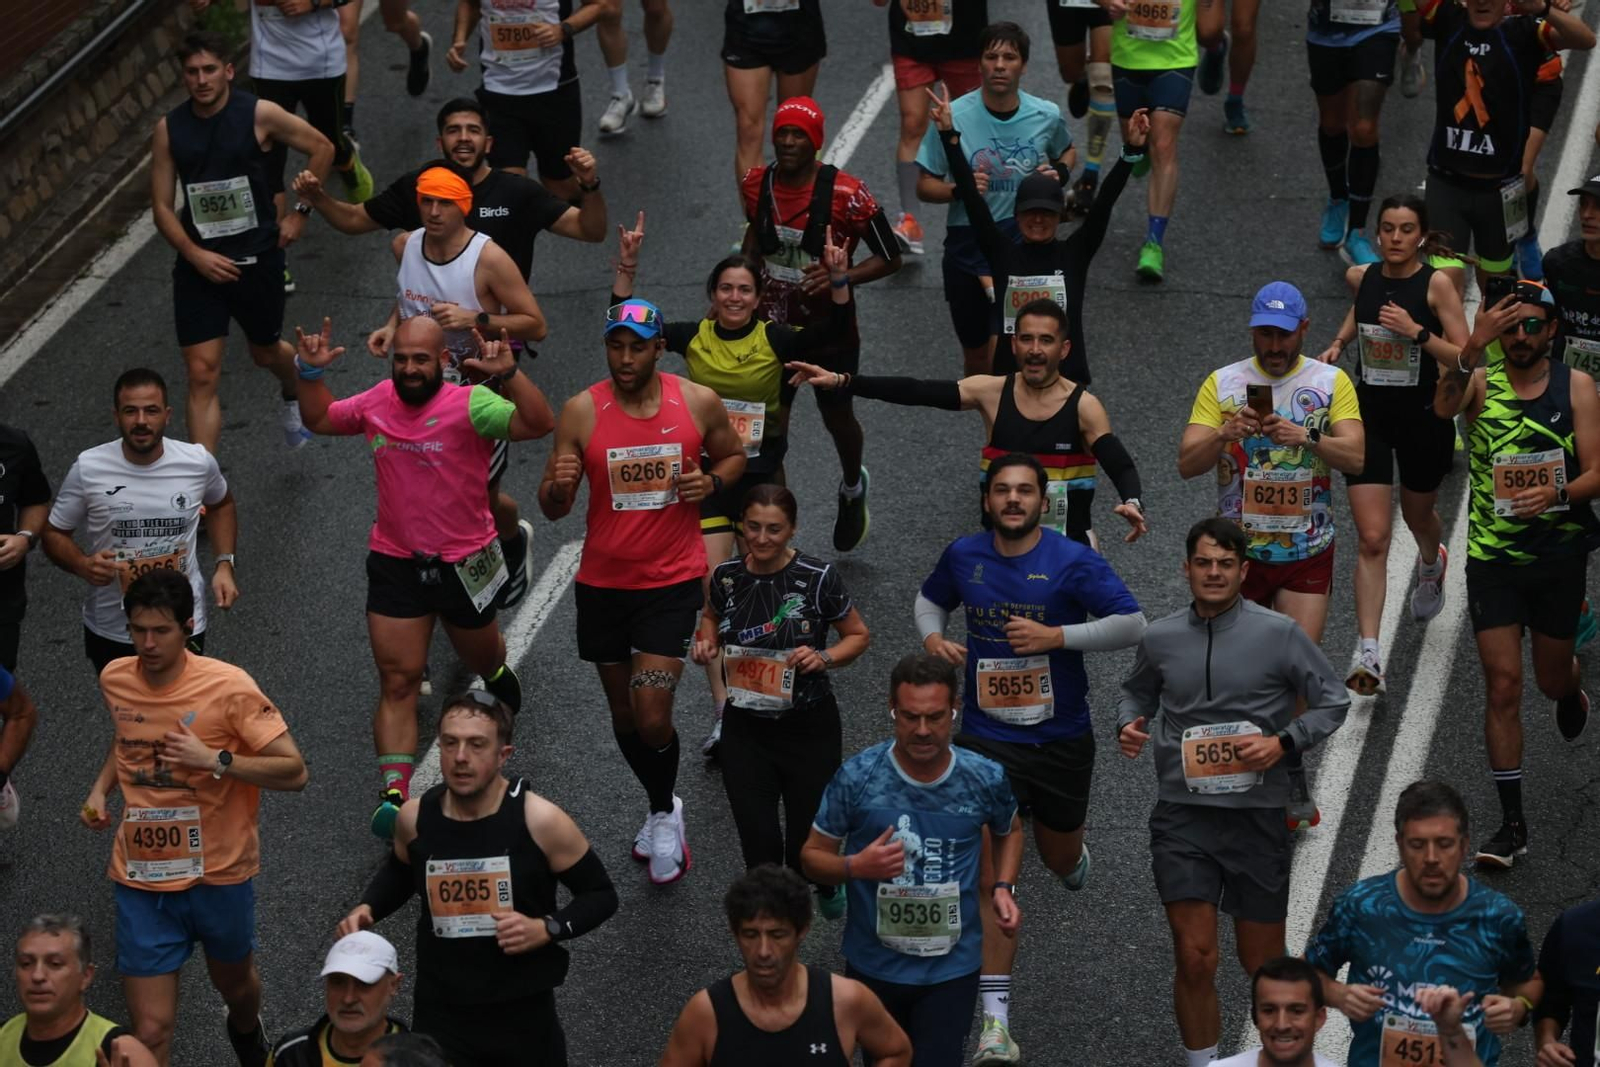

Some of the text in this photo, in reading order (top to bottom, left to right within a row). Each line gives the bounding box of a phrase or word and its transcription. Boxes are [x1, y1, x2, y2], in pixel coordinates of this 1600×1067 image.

[1135, 4, 1169, 19] 4968
[498, 27, 531, 42] 5780
[1446, 126, 1496, 155] ELA
[199, 193, 237, 213] 9521
[479, 206, 510, 218] Birds
[1366, 339, 1404, 361] 7393
[621, 461, 666, 483] 6266
[1504, 467, 1549, 488] 5826
[1254, 485, 1298, 505] 6213
[967, 605, 1045, 621] FUENTES
[737, 661, 776, 684] 4971
[988, 675, 1034, 696] 5655
[133, 826, 181, 848] 4390
[439, 879, 490, 903] 6265
[890, 903, 941, 924] 9536
